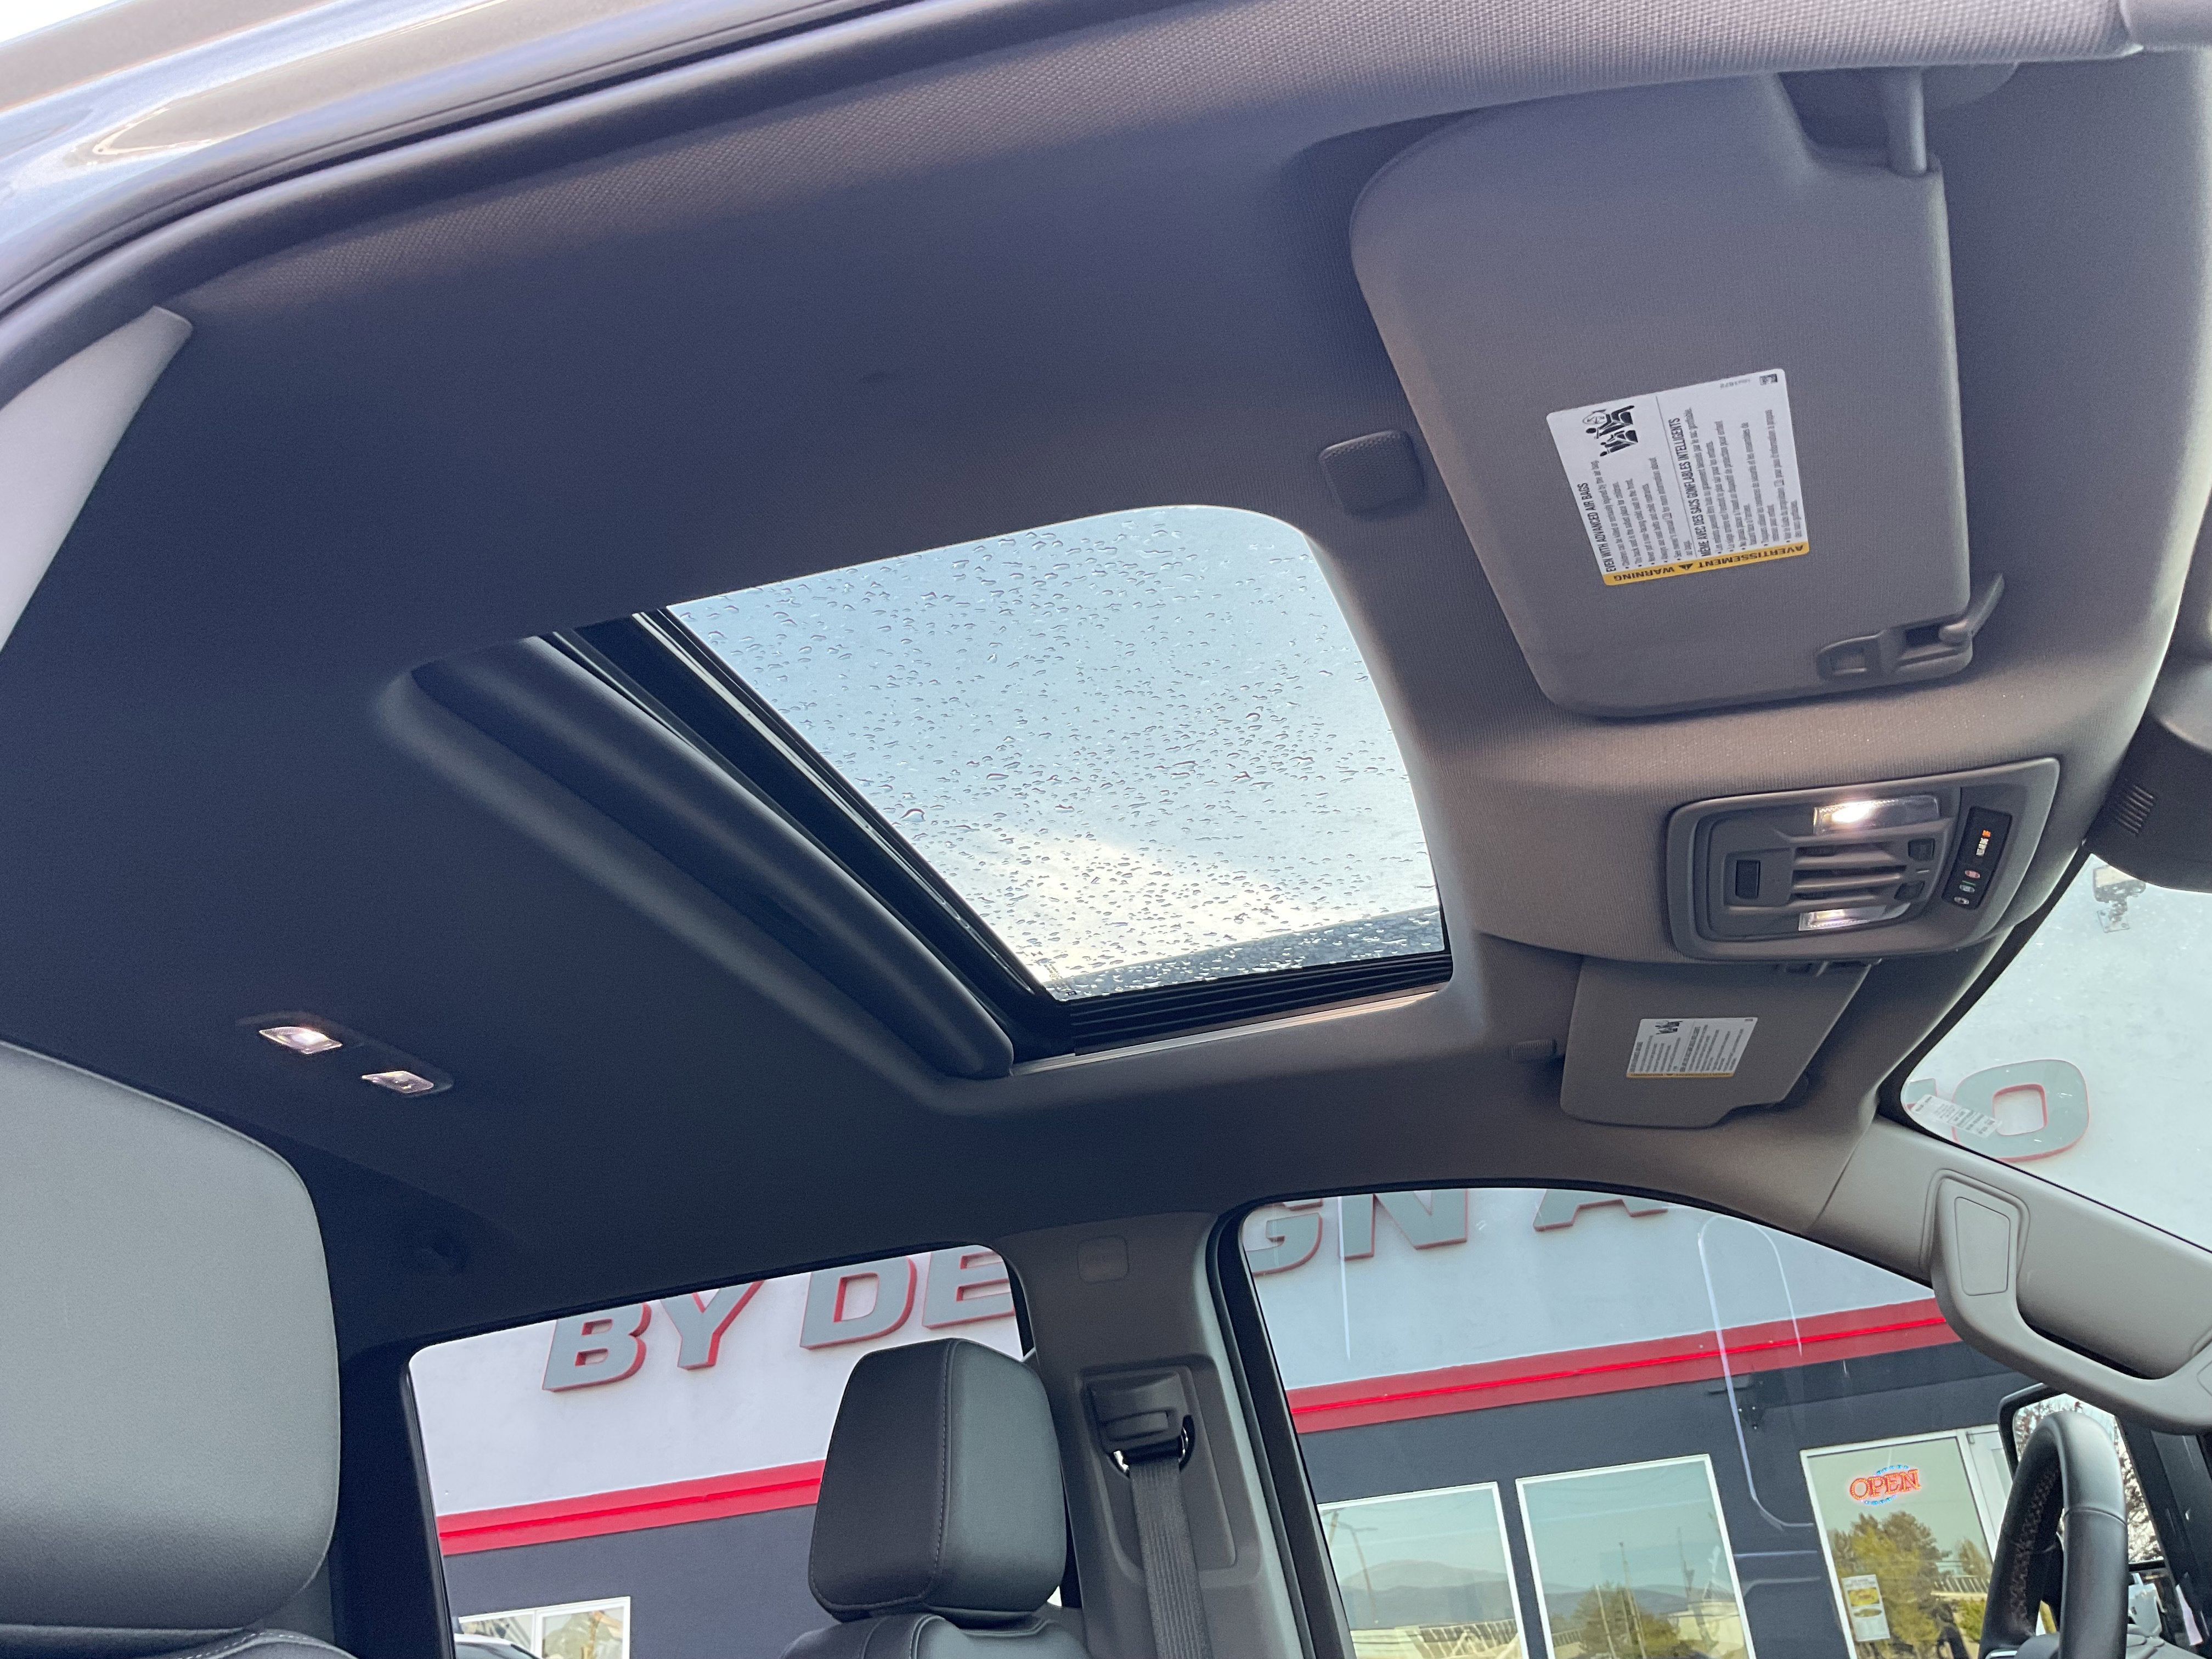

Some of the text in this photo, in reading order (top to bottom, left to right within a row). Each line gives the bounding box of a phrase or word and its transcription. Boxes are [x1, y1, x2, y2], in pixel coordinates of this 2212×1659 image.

[1577, 482, 1616, 572] EVEN WITH ADVANCED AIR BAGS
[1697, 545, 1803, 567] AVERTISSEMENT
[1613, 566, 1674, 580] WARNING
[542, 1280, 765, 1392] BY
[1849, 1469, 1921, 1500] OPEN
